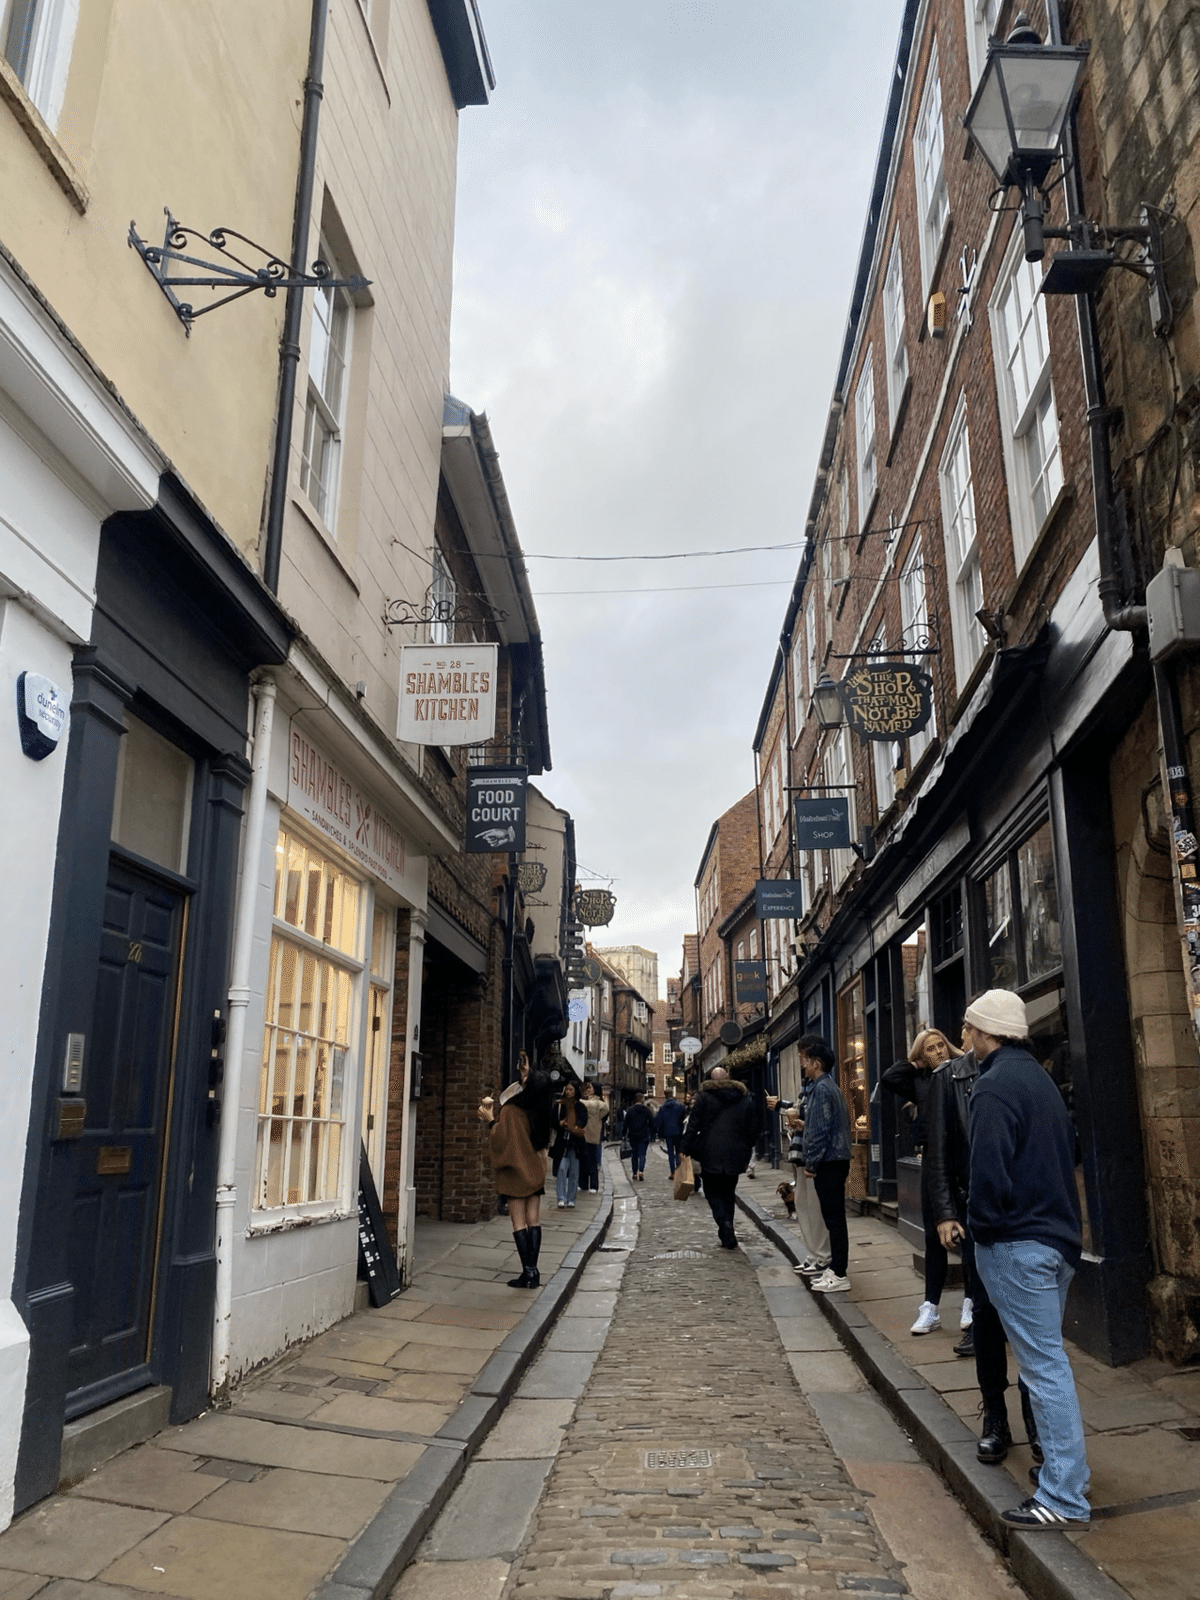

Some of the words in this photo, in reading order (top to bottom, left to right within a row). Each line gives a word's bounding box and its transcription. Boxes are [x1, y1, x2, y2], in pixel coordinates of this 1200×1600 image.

[450, 660, 461, 669] 28
[406, 671, 490, 695] SHAMBLES
[856, 672, 912, 695] SHOP
[37, 693, 65, 720] dunelm
[414, 698, 479, 721] KITCHEN
[850, 695, 888, 707] THAT
[39, 709, 62, 731] security
[852, 704, 891, 724] NOT
[891, 705, 920, 719] BE
[863, 719, 912, 734] NAMED
[292, 732, 352, 829] SHAMBLES
[373, 810, 406, 877] KITCHEN
[477, 789, 515, 804] FOOD
[471, 807, 521, 822] COURT
[343, 835, 347, 846] &
